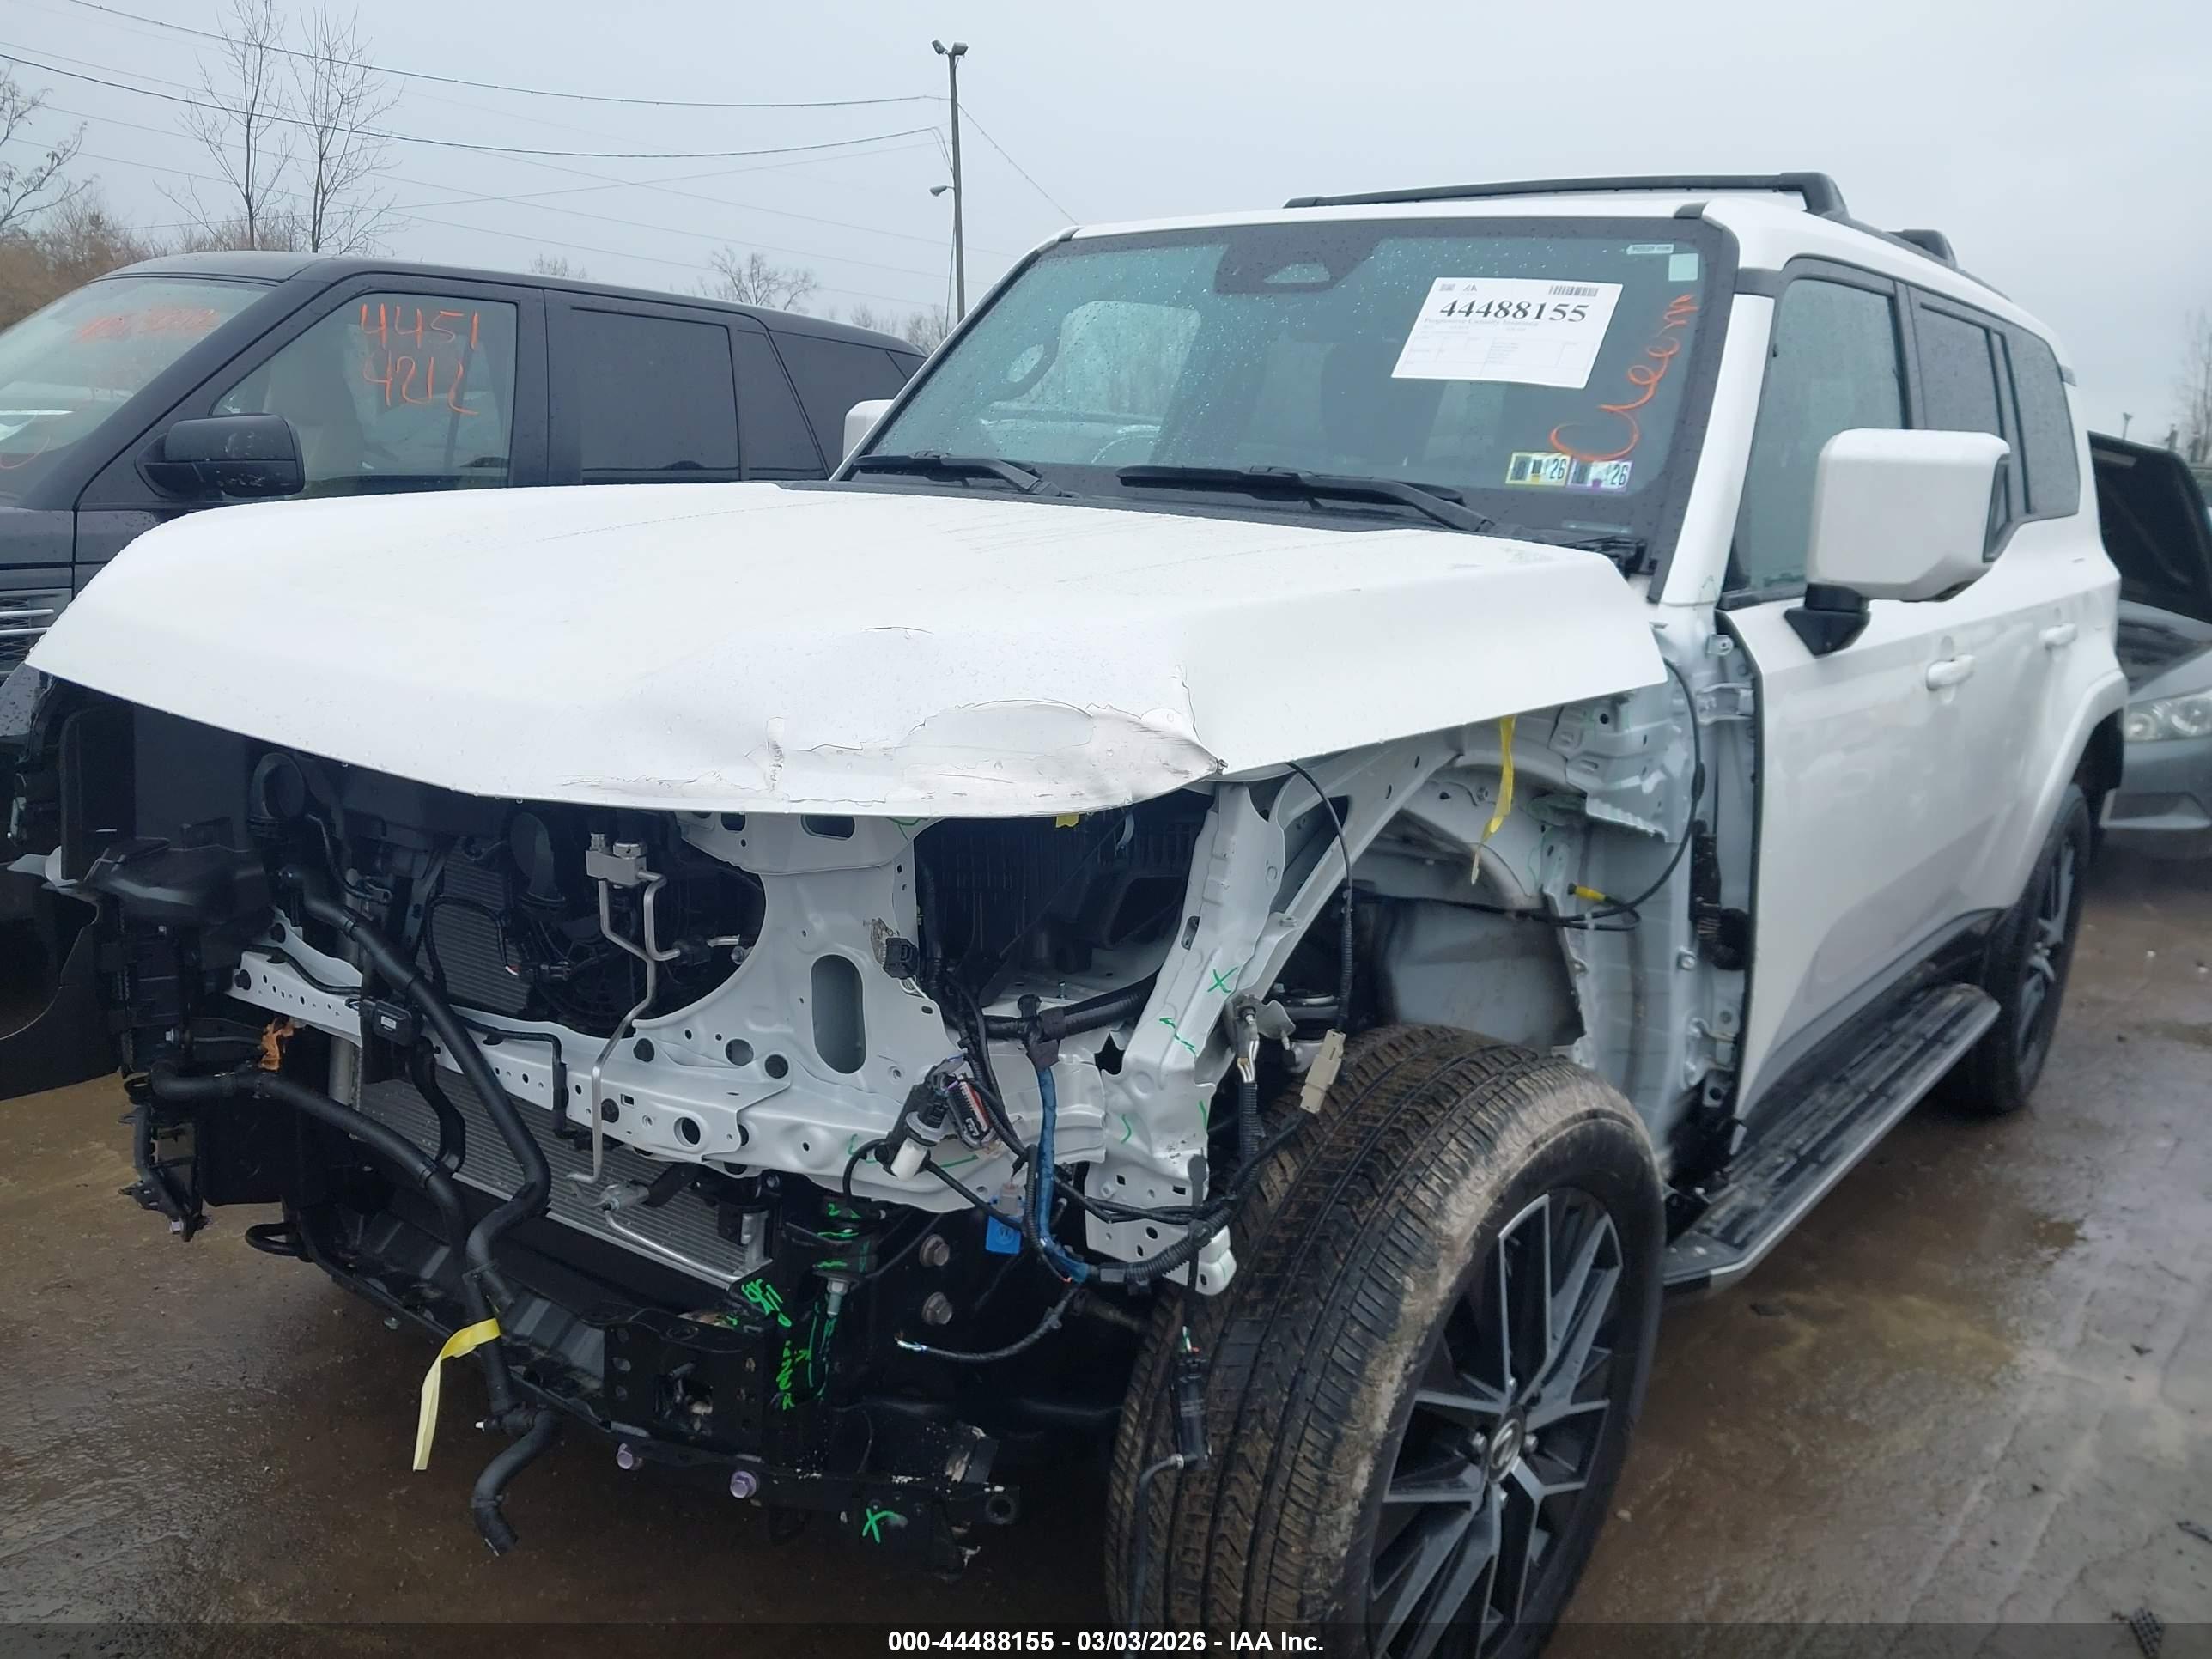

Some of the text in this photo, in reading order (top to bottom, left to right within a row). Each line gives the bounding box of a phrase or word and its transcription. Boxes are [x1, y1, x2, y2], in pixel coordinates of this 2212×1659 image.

[1439, 299, 1590, 323] 44488155
[360, 303, 479, 351] 4451
[1549, 458, 1567, 480] 26
[1610, 463, 1629, 486] 26
